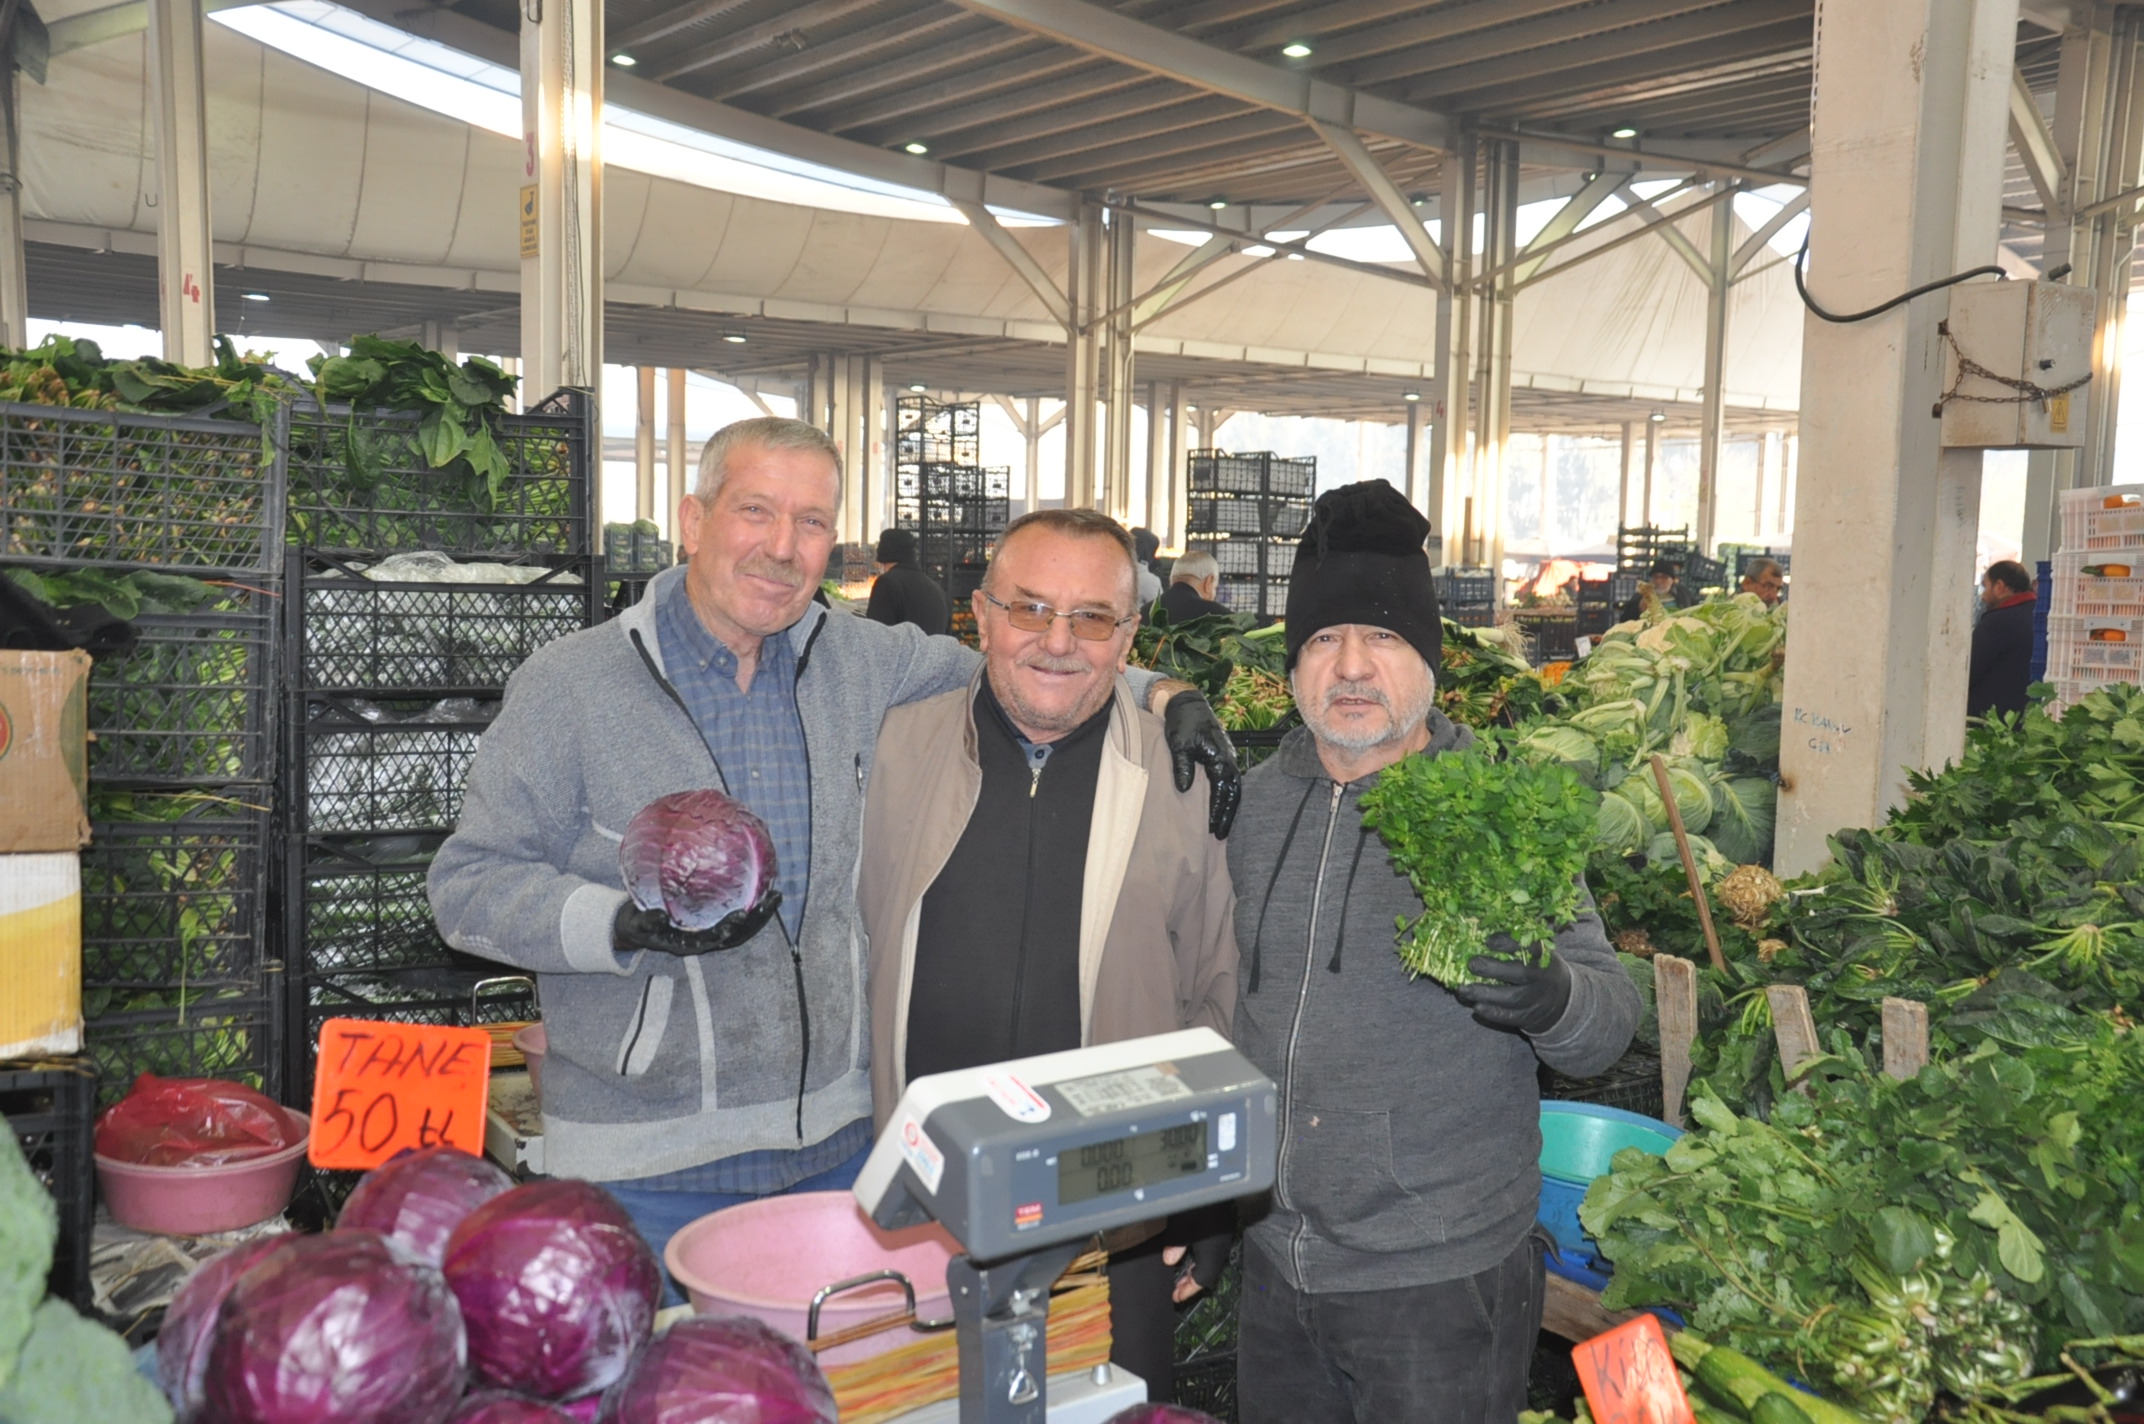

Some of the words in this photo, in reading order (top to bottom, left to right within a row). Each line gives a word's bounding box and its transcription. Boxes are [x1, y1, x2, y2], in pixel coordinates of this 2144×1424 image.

[525, 131, 535, 177] 3
[182, 273, 200, 303] 4
[338, 1032, 484, 1077] TANE
[314, 1089, 399, 1157] 50
